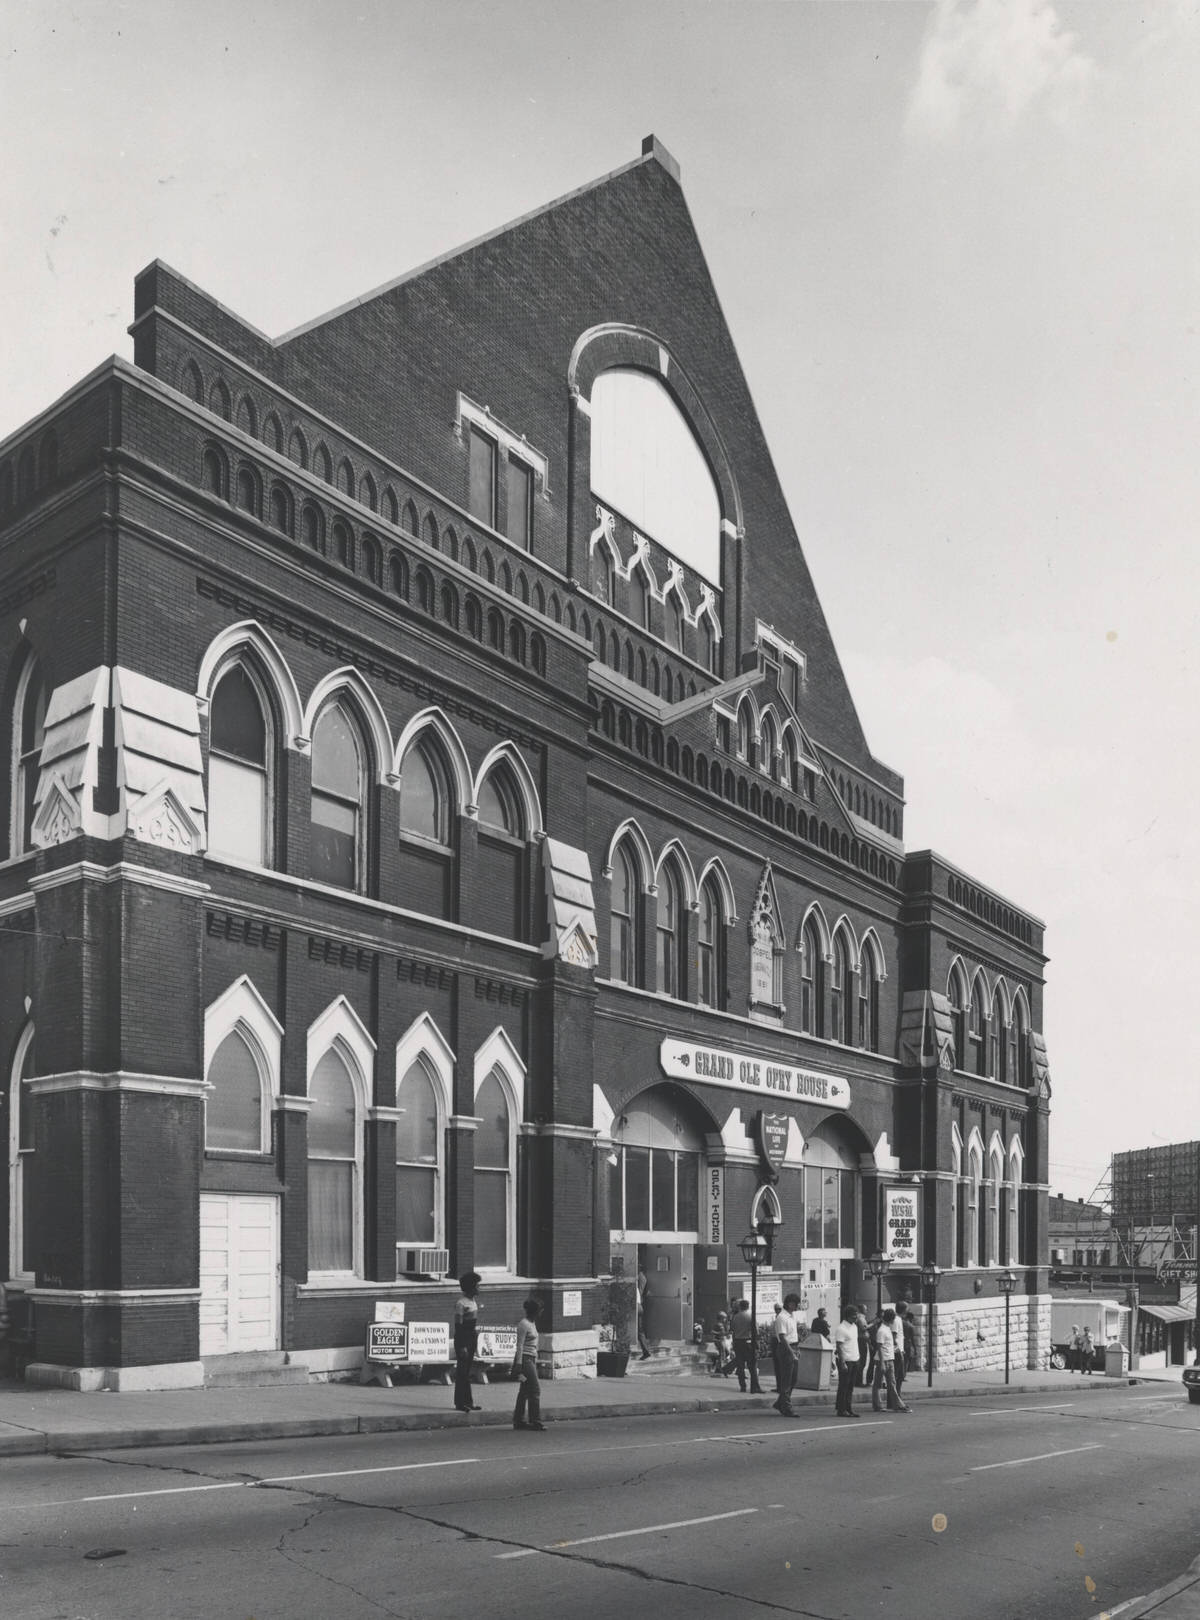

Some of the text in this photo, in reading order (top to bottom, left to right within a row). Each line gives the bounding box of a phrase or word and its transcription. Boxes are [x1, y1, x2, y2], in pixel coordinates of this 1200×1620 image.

[695, 1051, 828, 1099] GRAND OLE OPRY HOUSE
[888, 1218, 916, 1228] GRAND
[895, 1228, 910, 1238] OLE
[892, 1238, 914, 1248] OPRY
[1160, 1270, 1181, 1278] GIFT
[373, 1328, 404, 1337] GOLDEN
[376, 1336, 400, 1344] EAGLE
[495, 1334, 517, 1344] RUDY'S
